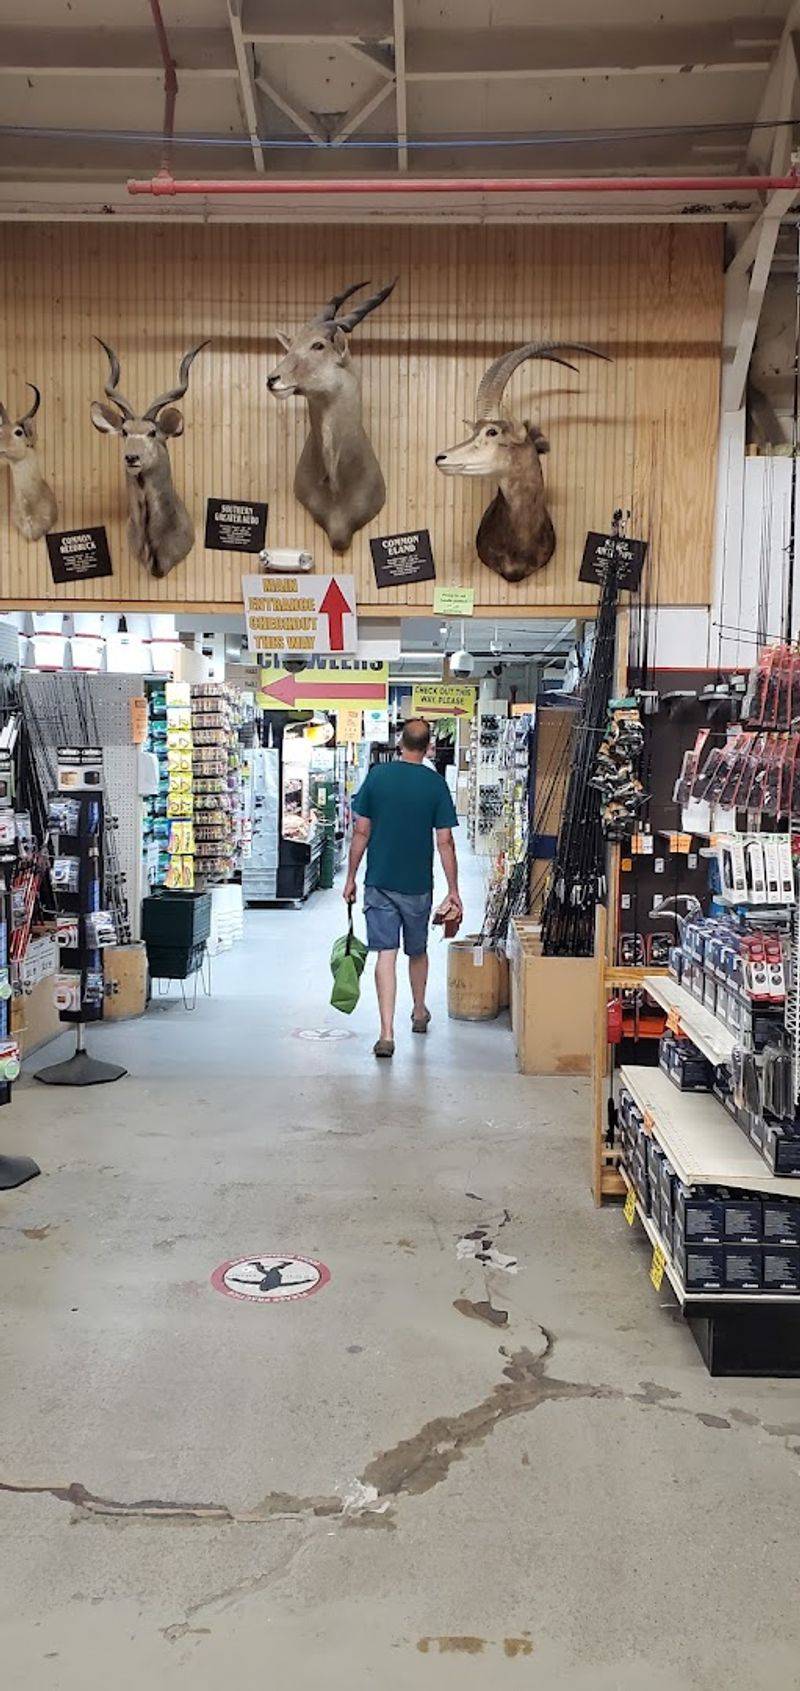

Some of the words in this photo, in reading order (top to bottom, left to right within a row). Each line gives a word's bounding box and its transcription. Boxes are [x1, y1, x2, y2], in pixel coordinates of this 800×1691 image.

[382, 535, 420, 549] COMMON
[388, 544, 416, 555] ELAND
[262, 578, 298, 592] MAIN
[248, 597, 316, 611] ENTRANCE
[249, 616, 318, 631] CHECKOUT
[255, 636, 285, 649] THIS
[288, 636, 316, 649] WAY
[415, 686, 438, 695] CHECK
[439, 688, 454, 696] OUT
[456, 689, 472, 697] THIS
[420, 695, 436, 703] WAY
[439, 697, 465, 705] PLEASE
